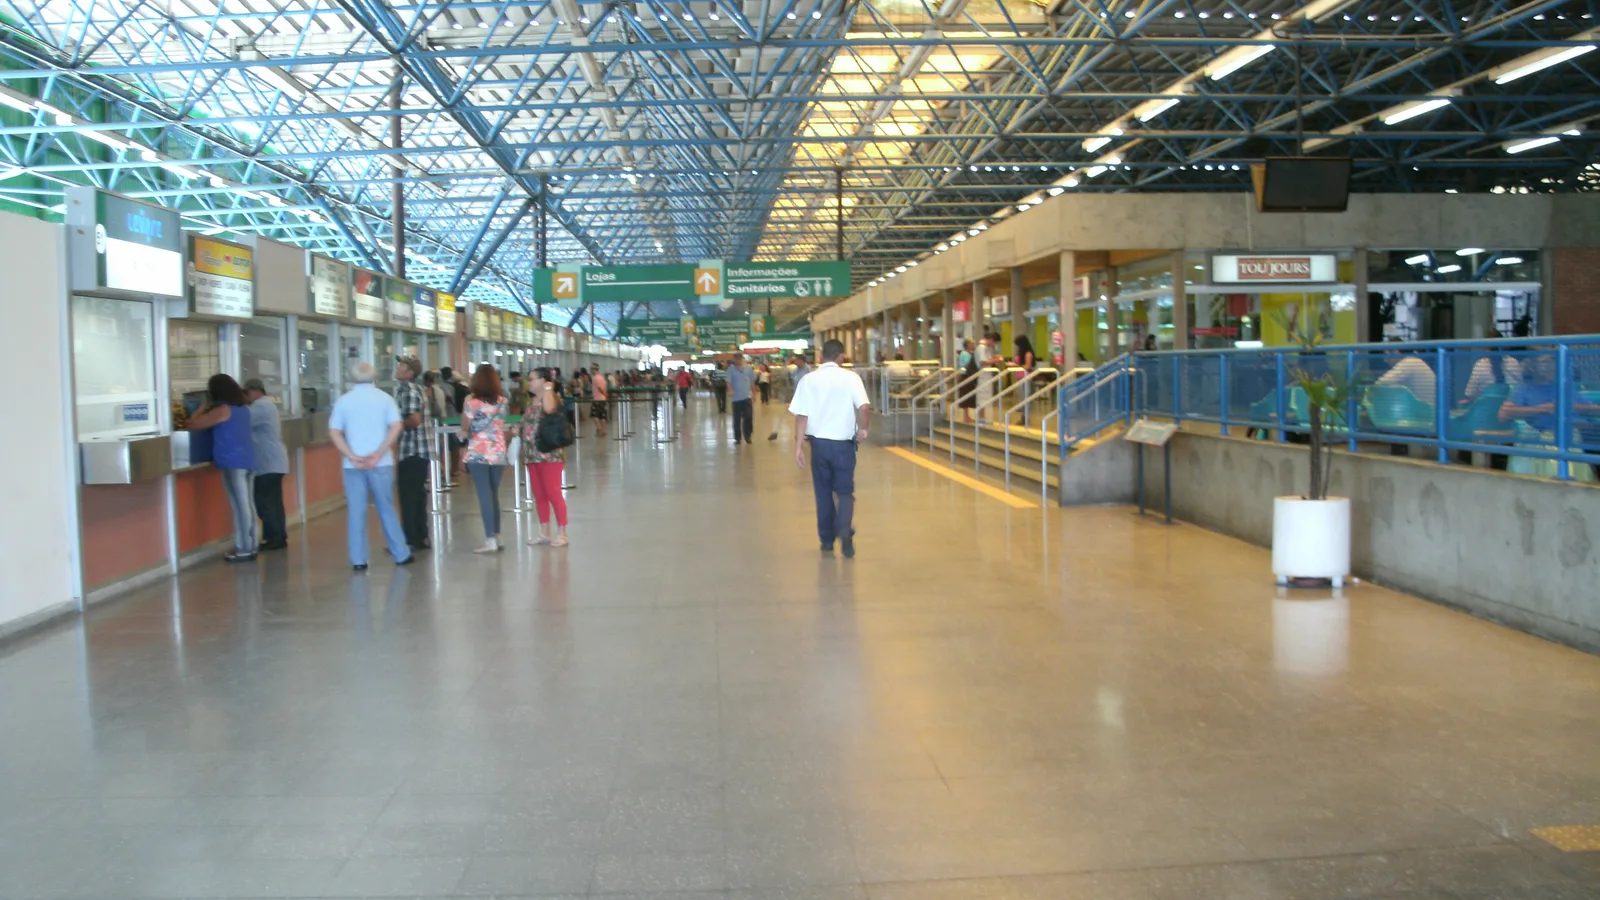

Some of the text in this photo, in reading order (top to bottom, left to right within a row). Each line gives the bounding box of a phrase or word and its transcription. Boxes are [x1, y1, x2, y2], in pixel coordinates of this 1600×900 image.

[585, 271, 616, 283] Lojas
[727, 267, 799, 278] Informações
[727, 284, 787, 294] Sanitários
